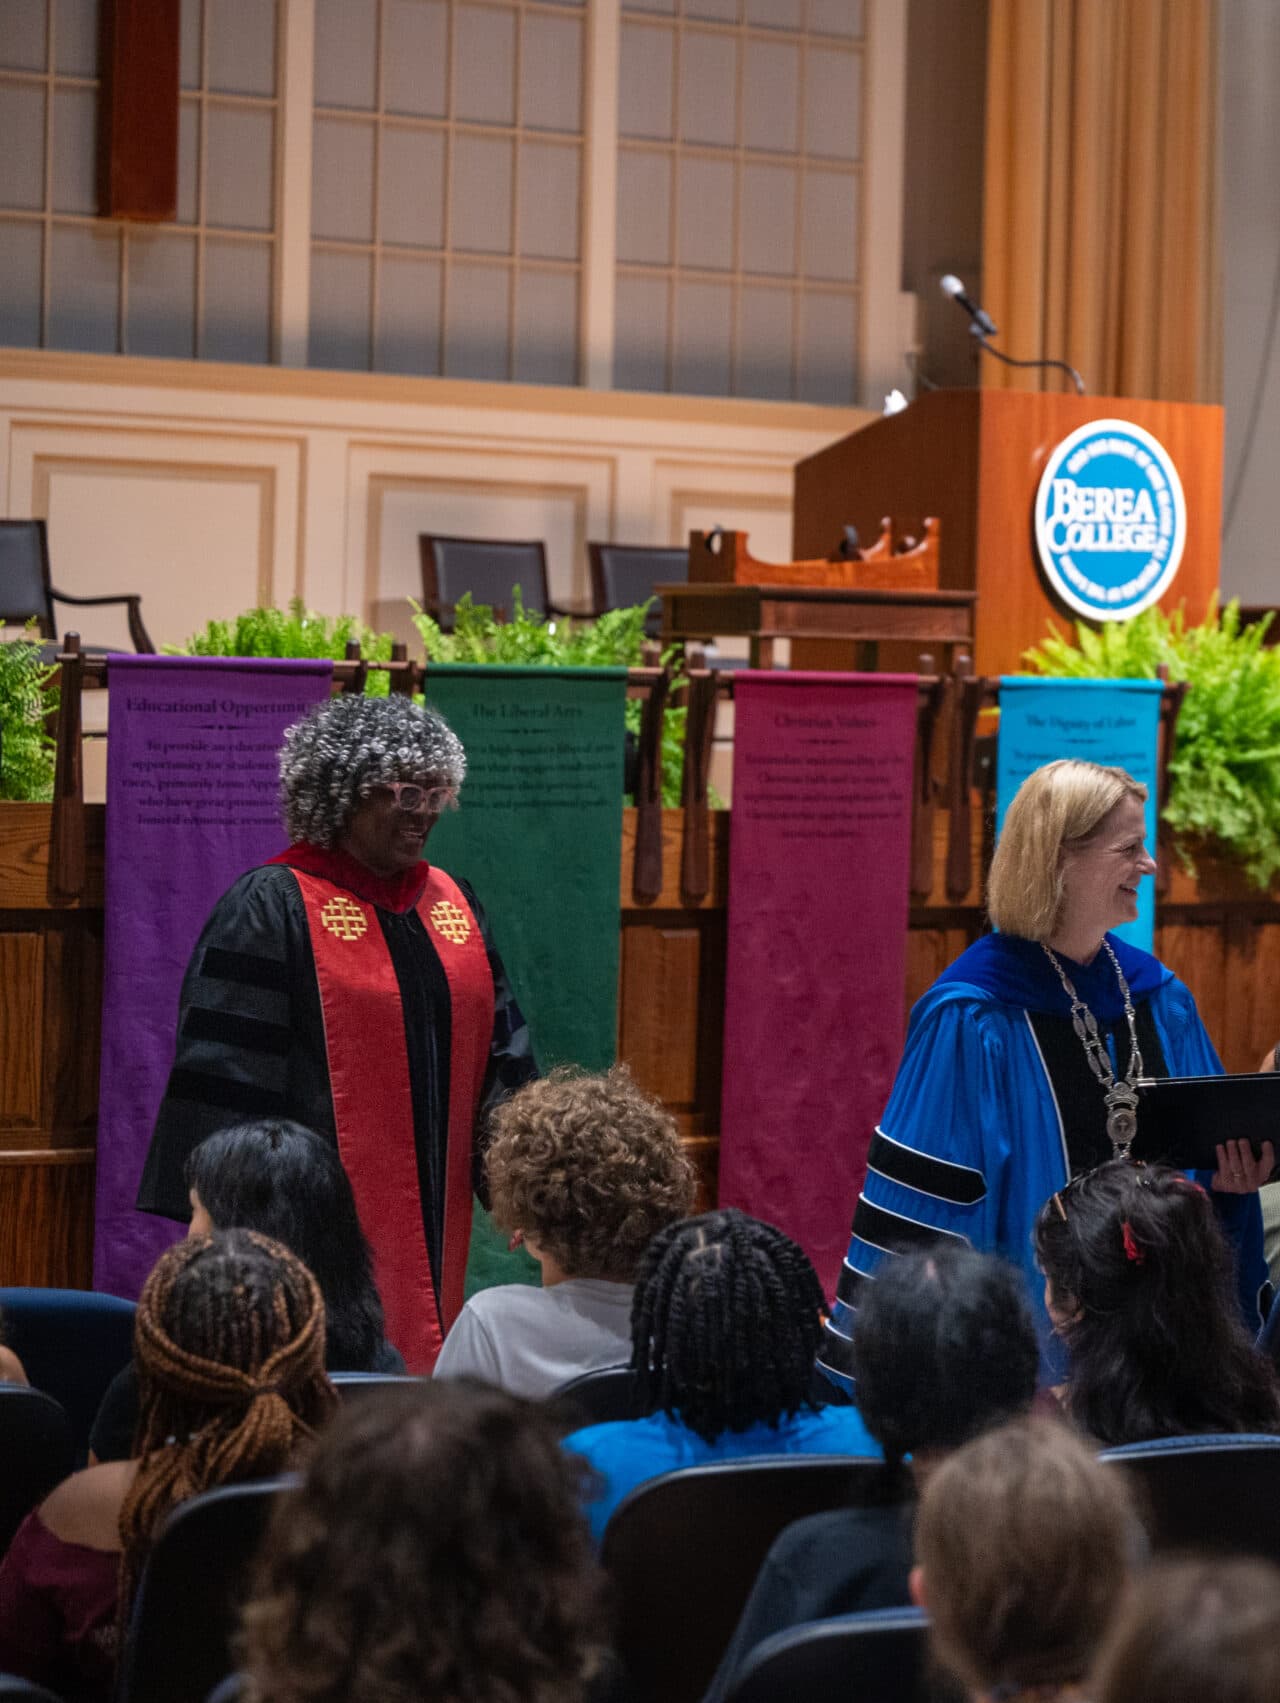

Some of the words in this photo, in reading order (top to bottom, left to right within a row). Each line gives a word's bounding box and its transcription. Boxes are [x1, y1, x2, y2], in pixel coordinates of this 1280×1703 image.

[1052, 478, 1157, 523] BEREA
[1044, 516, 1159, 554] COLLEGE
[127, 697, 217, 713] Educational
[220, 699, 307, 719] Opportunit
